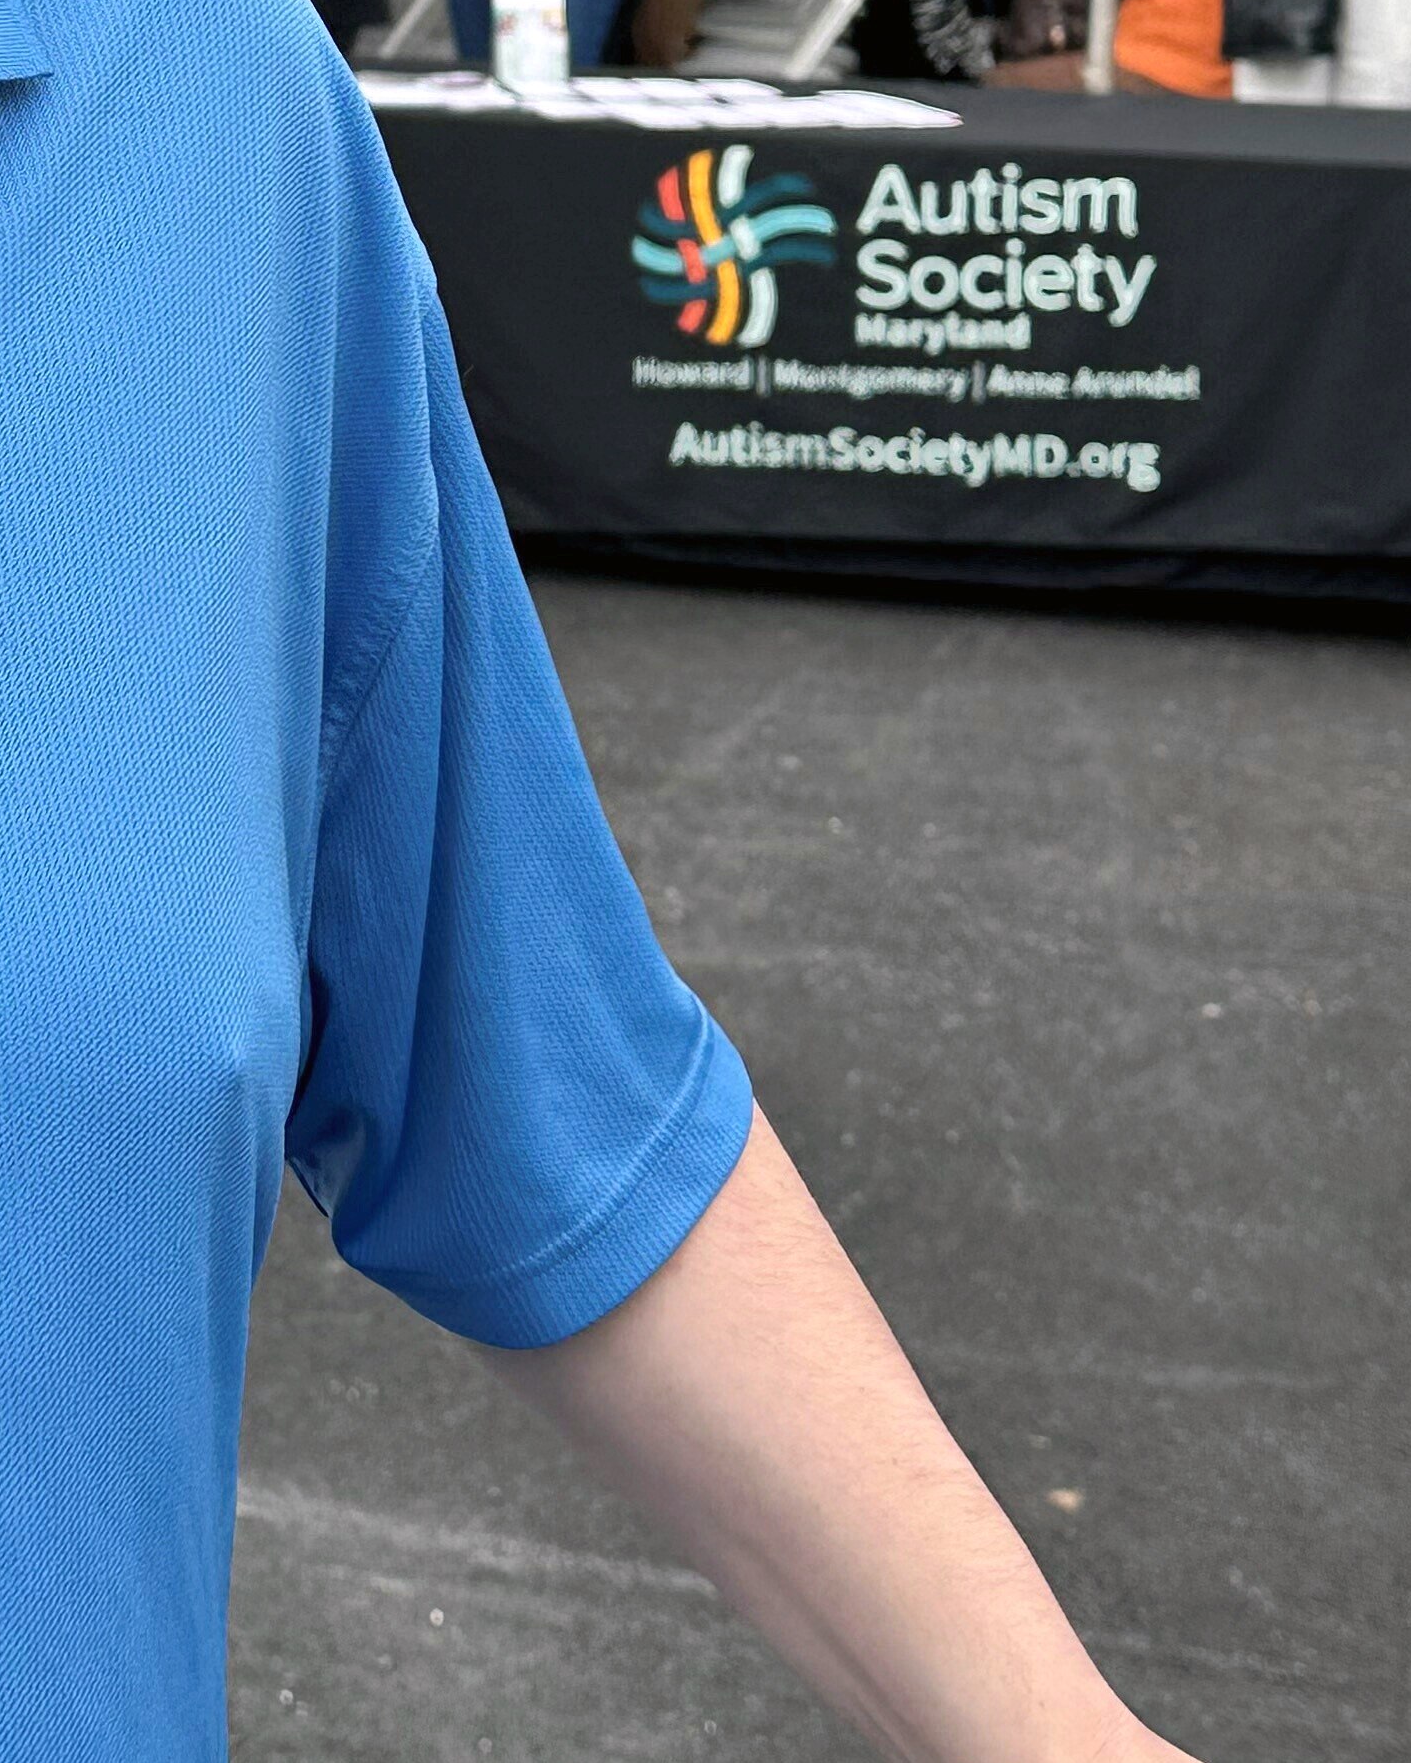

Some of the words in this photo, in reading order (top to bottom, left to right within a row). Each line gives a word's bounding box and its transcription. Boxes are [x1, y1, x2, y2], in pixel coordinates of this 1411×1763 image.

[855, 162, 1139, 238] Autism
[855, 237, 1158, 327] Society
[854, 311, 1032, 356] Maryland
[632, 355, 754, 390] Howard
[773, 359, 970, 403] Montgomery
[987, 363, 1071, 400] Anne
[1071, 364, 1201, 401] Arundel
[668, 420, 1162, 493] AutismSocietyMD.org
